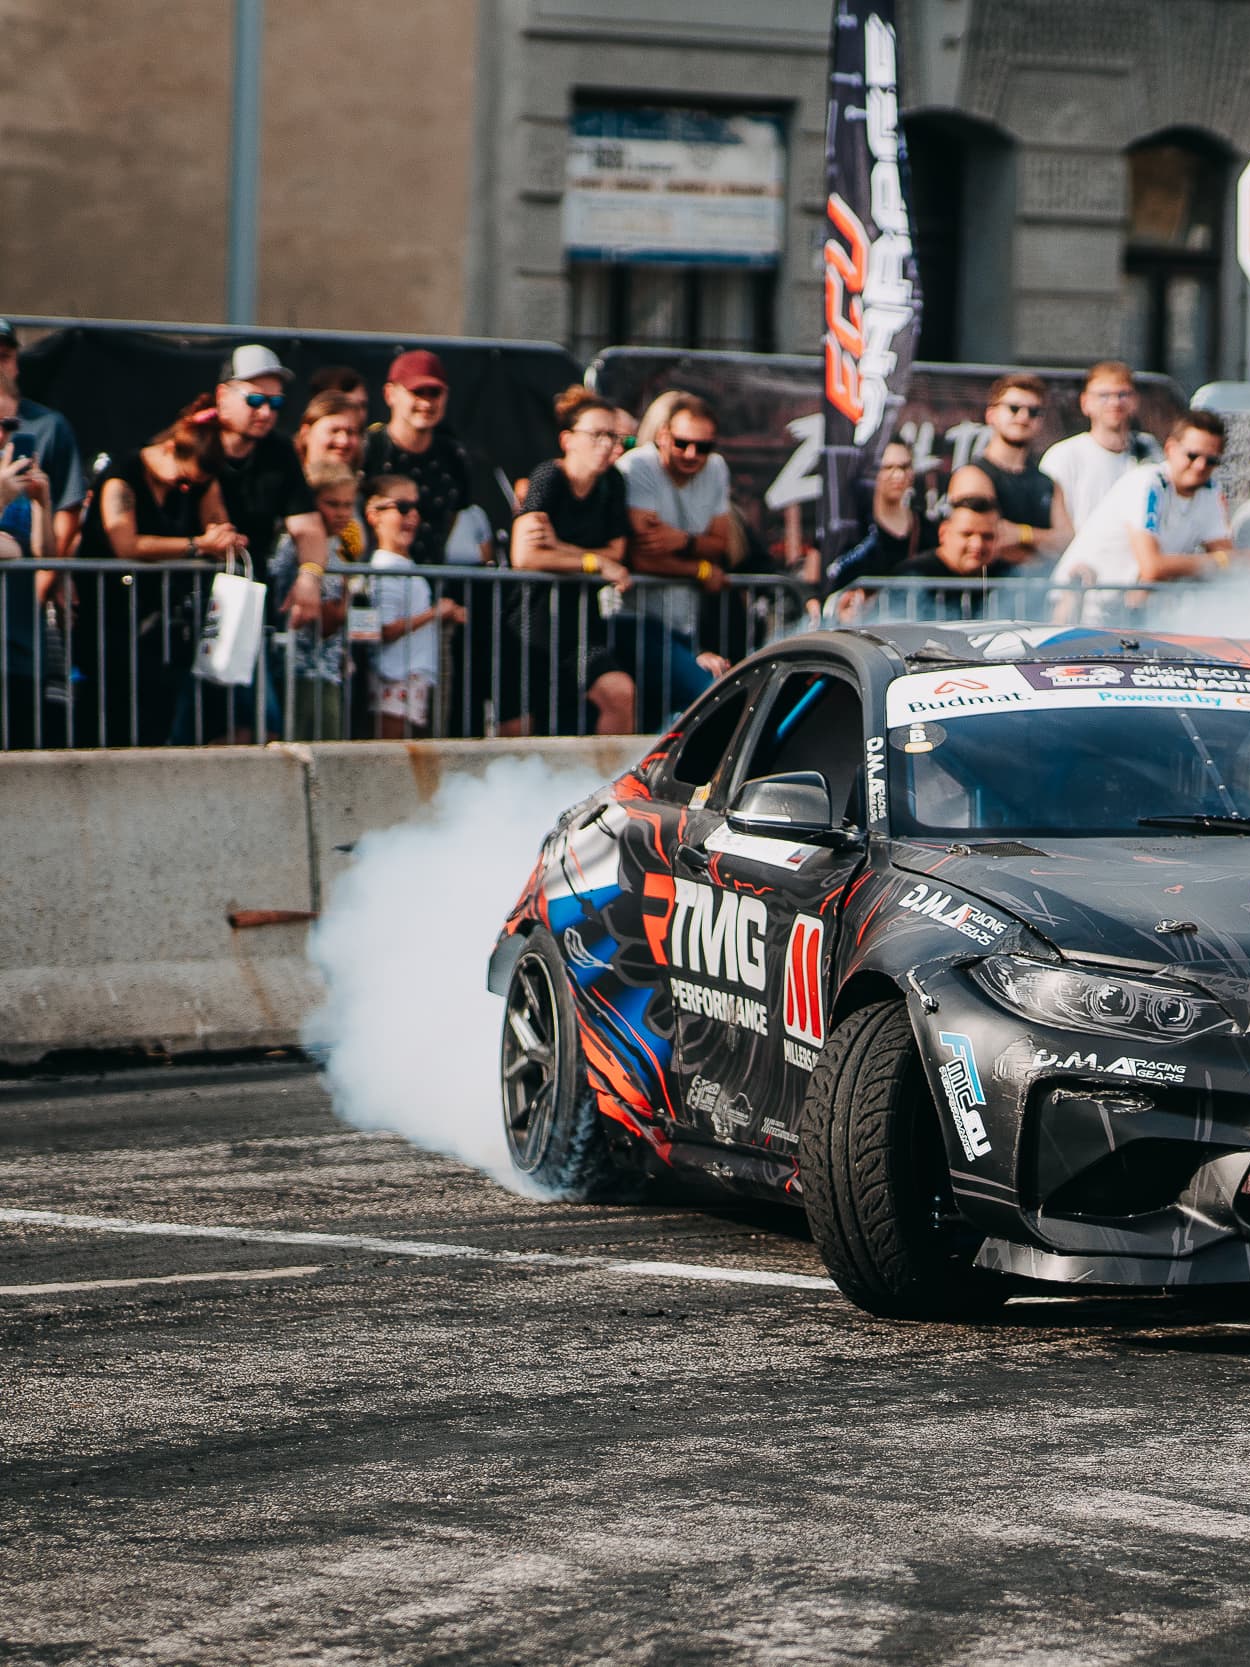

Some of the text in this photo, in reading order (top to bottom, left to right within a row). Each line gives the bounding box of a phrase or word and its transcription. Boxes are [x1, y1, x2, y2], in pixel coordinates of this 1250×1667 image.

[826, 193, 870, 424] ECU
[1133, 665, 1193, 678] official
[1194, 667, 1241, 681] ECU
[908, 691, 1033, 713] Budmat.
[1098, 691, 1192, 703] Powered
[1195, 694, 1222, 707] by
[967, 904, 1008, 935] RACING
[672, 876, 768, 992] TMG
[959, 922, 996, 946] GEARS
[670, 977, 769, 1037] PERFORMANCE
[784, 1038, 814, 1073] MILLERS
[1133, 1058, 1188, 1075] RACING
[1136, 1068, 1185, 1083] GEARS
